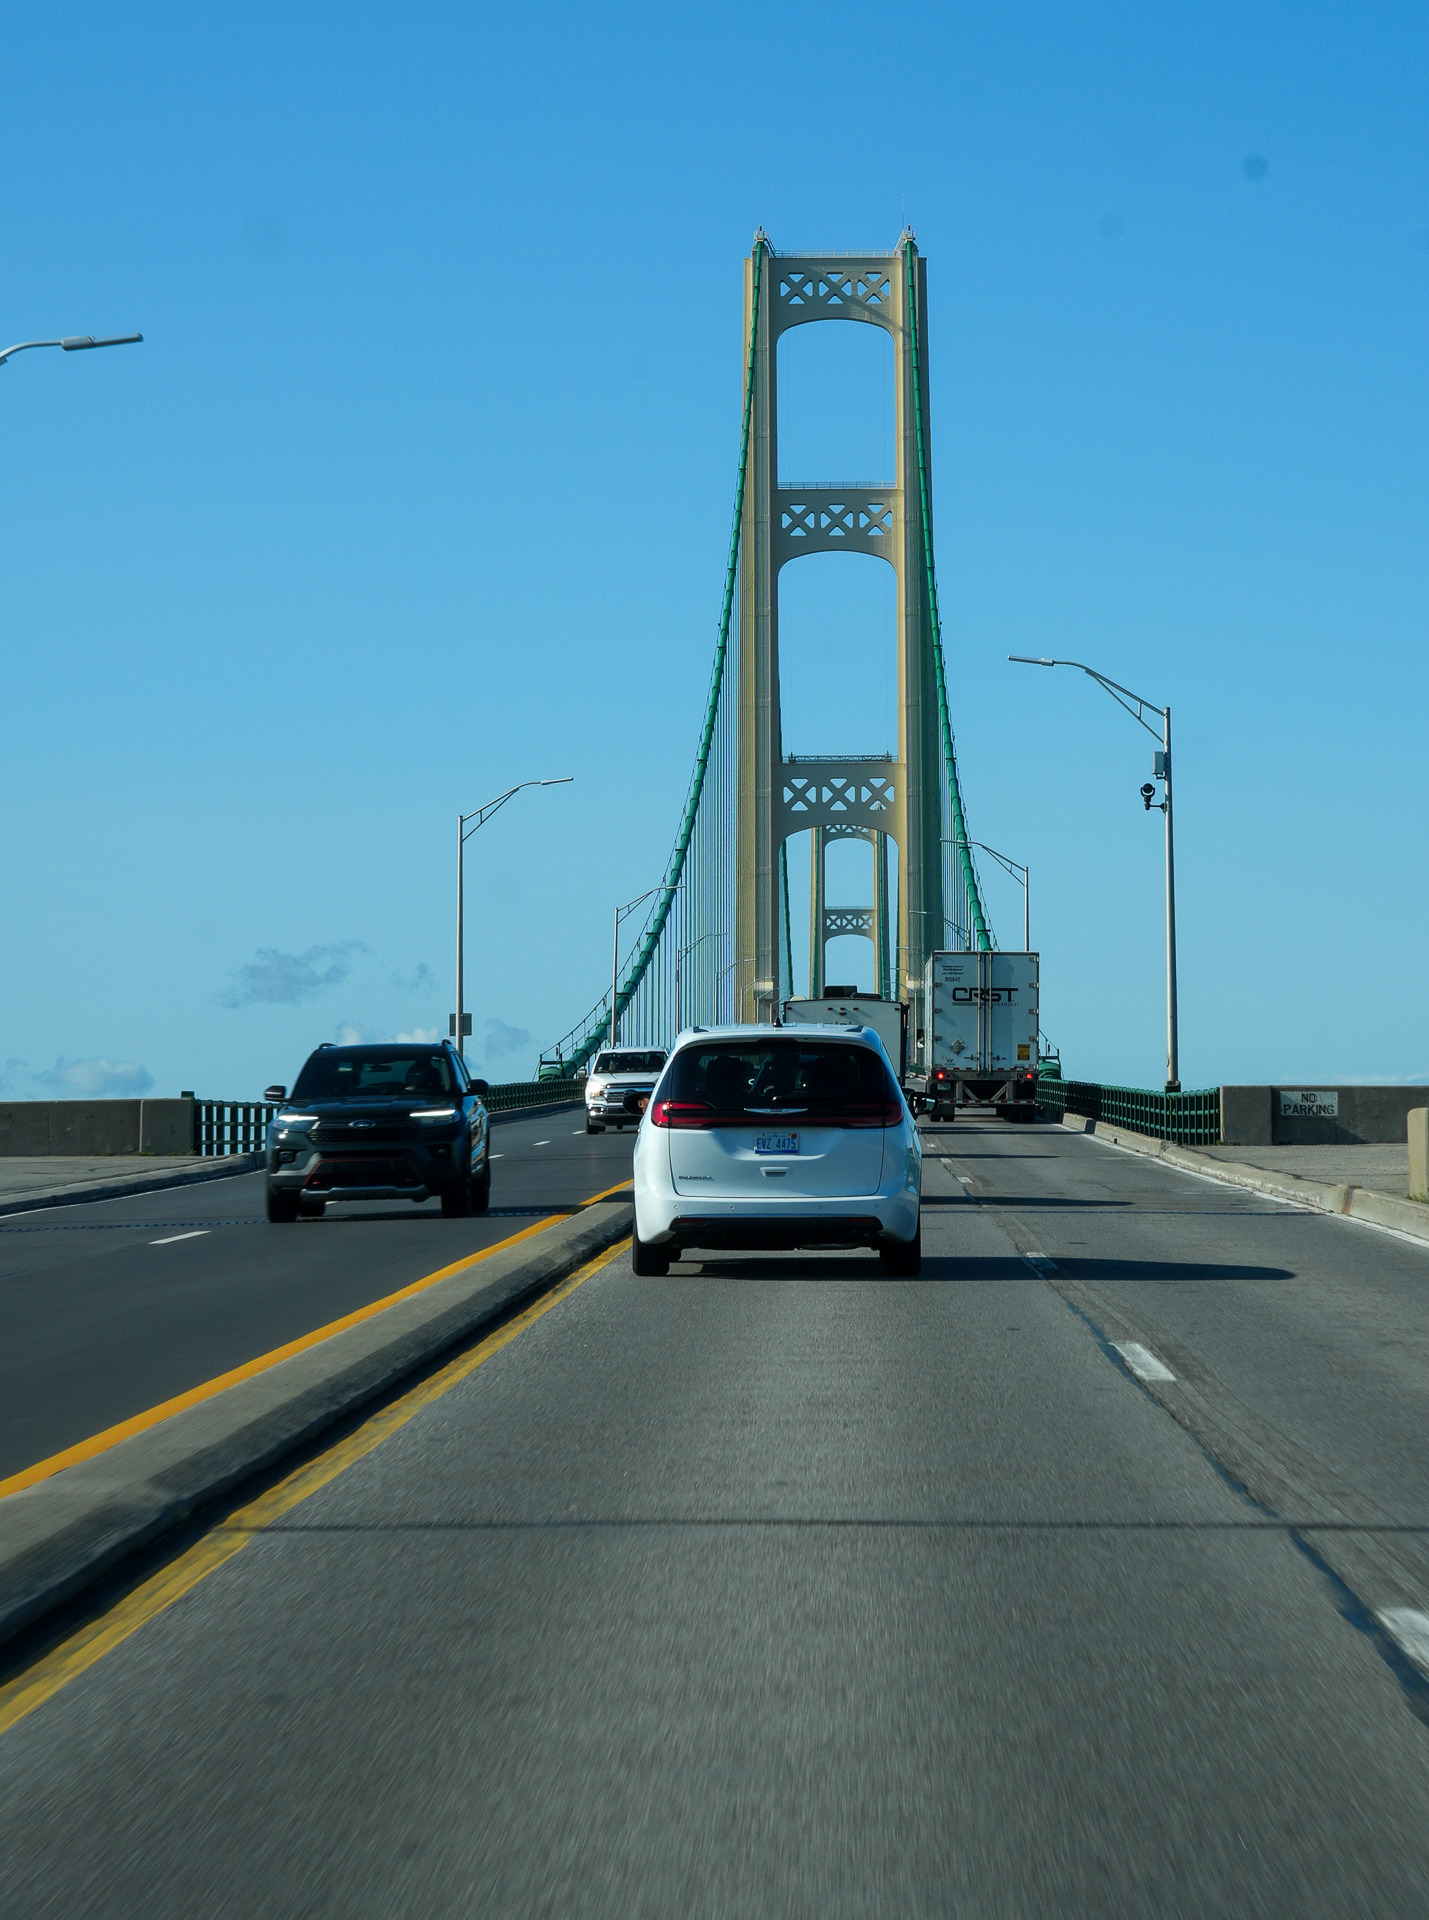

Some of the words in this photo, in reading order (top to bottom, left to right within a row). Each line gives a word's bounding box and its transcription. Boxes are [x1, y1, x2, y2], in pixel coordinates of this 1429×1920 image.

[952, 987, 1019, 1002] CRST
[1301, 1093, 1316, 1103] NO
[1283, 1104, 1335, 1115] PARKING
[776, 1137, 796, 1149] 4475
